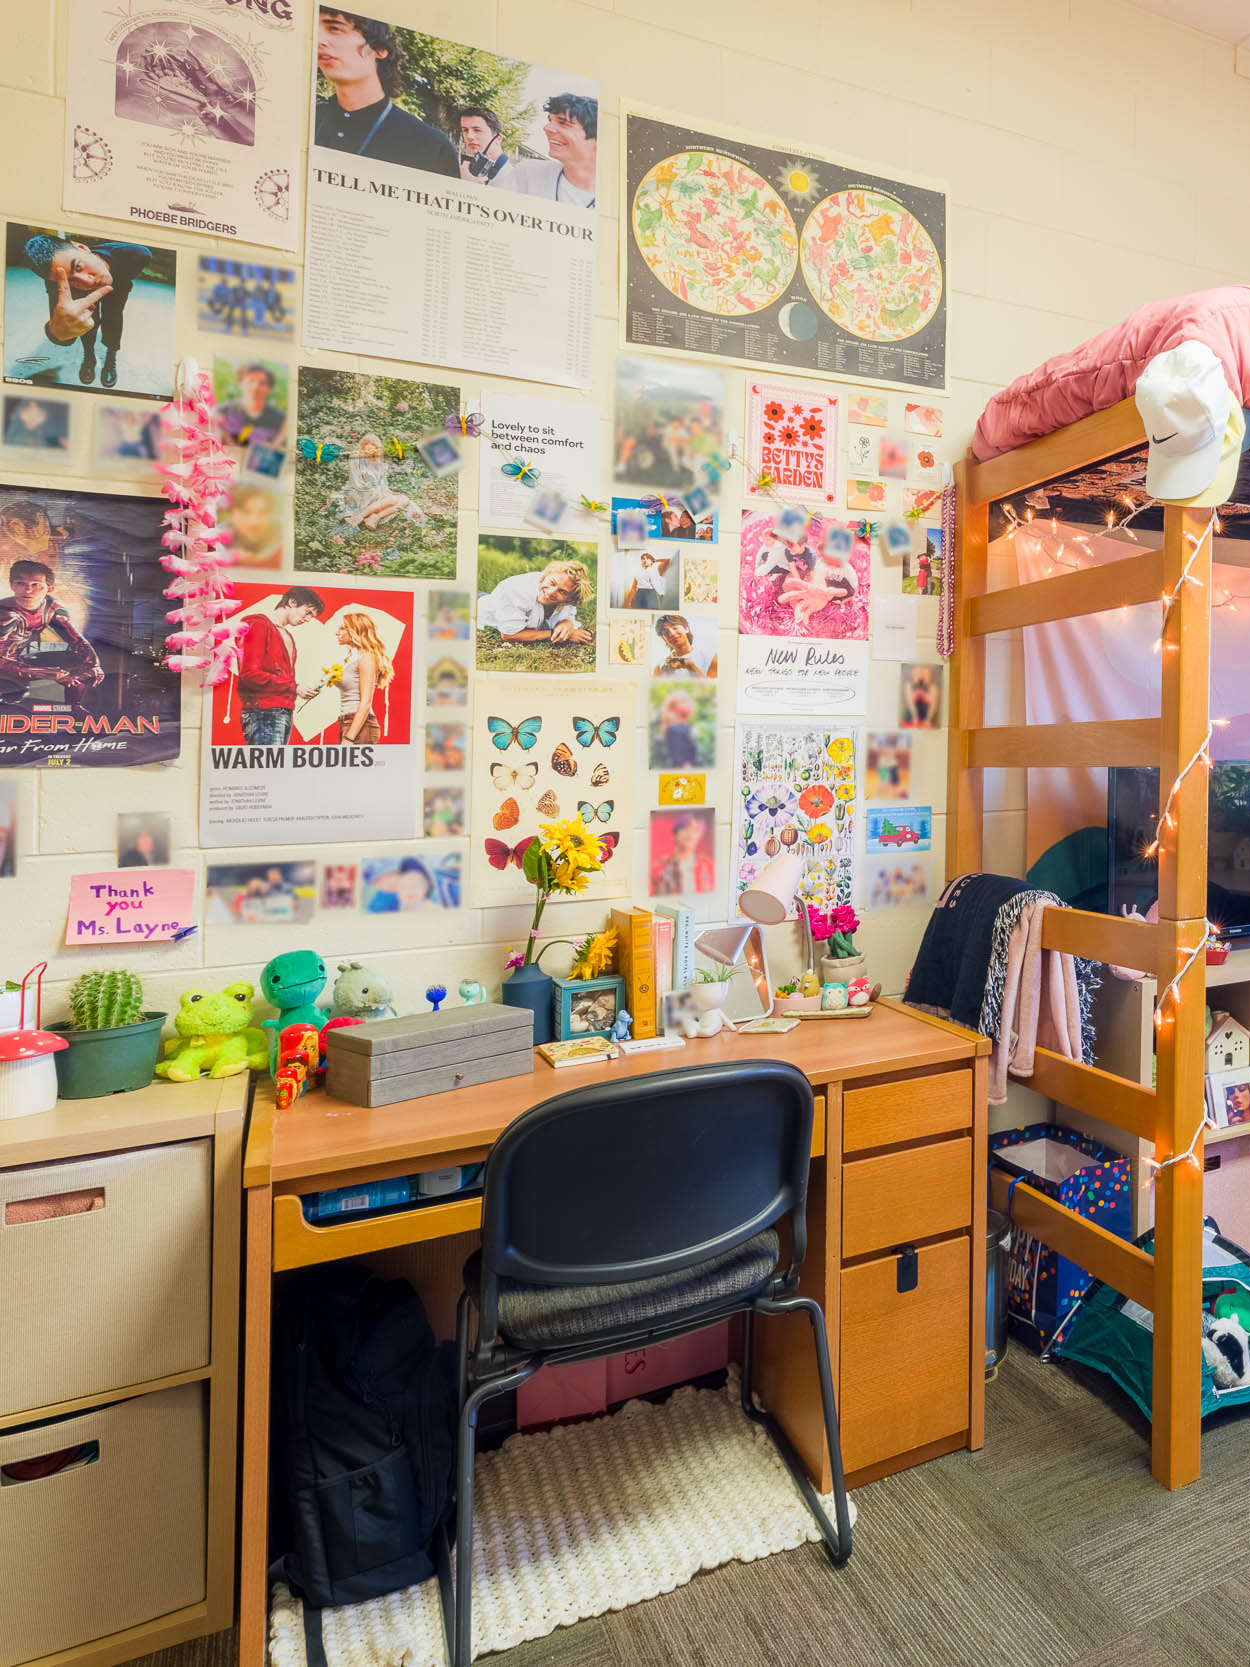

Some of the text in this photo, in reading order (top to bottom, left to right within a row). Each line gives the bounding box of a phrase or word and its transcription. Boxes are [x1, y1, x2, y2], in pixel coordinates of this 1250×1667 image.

[312, 168, 594, 241] TELL ME THAT IT'S OVER TOUR
[130, 206, 237, 235] PHOEBE BRIDGERS
[491, 419, 555, 436] Lovely to sit
[490, 441, 546, 455] and chaos
[491, 429, 584, 449] between comfort
[20, 739, 70, 754] From
[47, 758, 64, 766] JULY
[211, 747, 285, 770] WARM
[292, 746, 375, 768] BODIES
[90, 880, 155, 898] Thank
[105, 900, 144, 917] you
[77, 917, 180, 939] Ms. Layne
